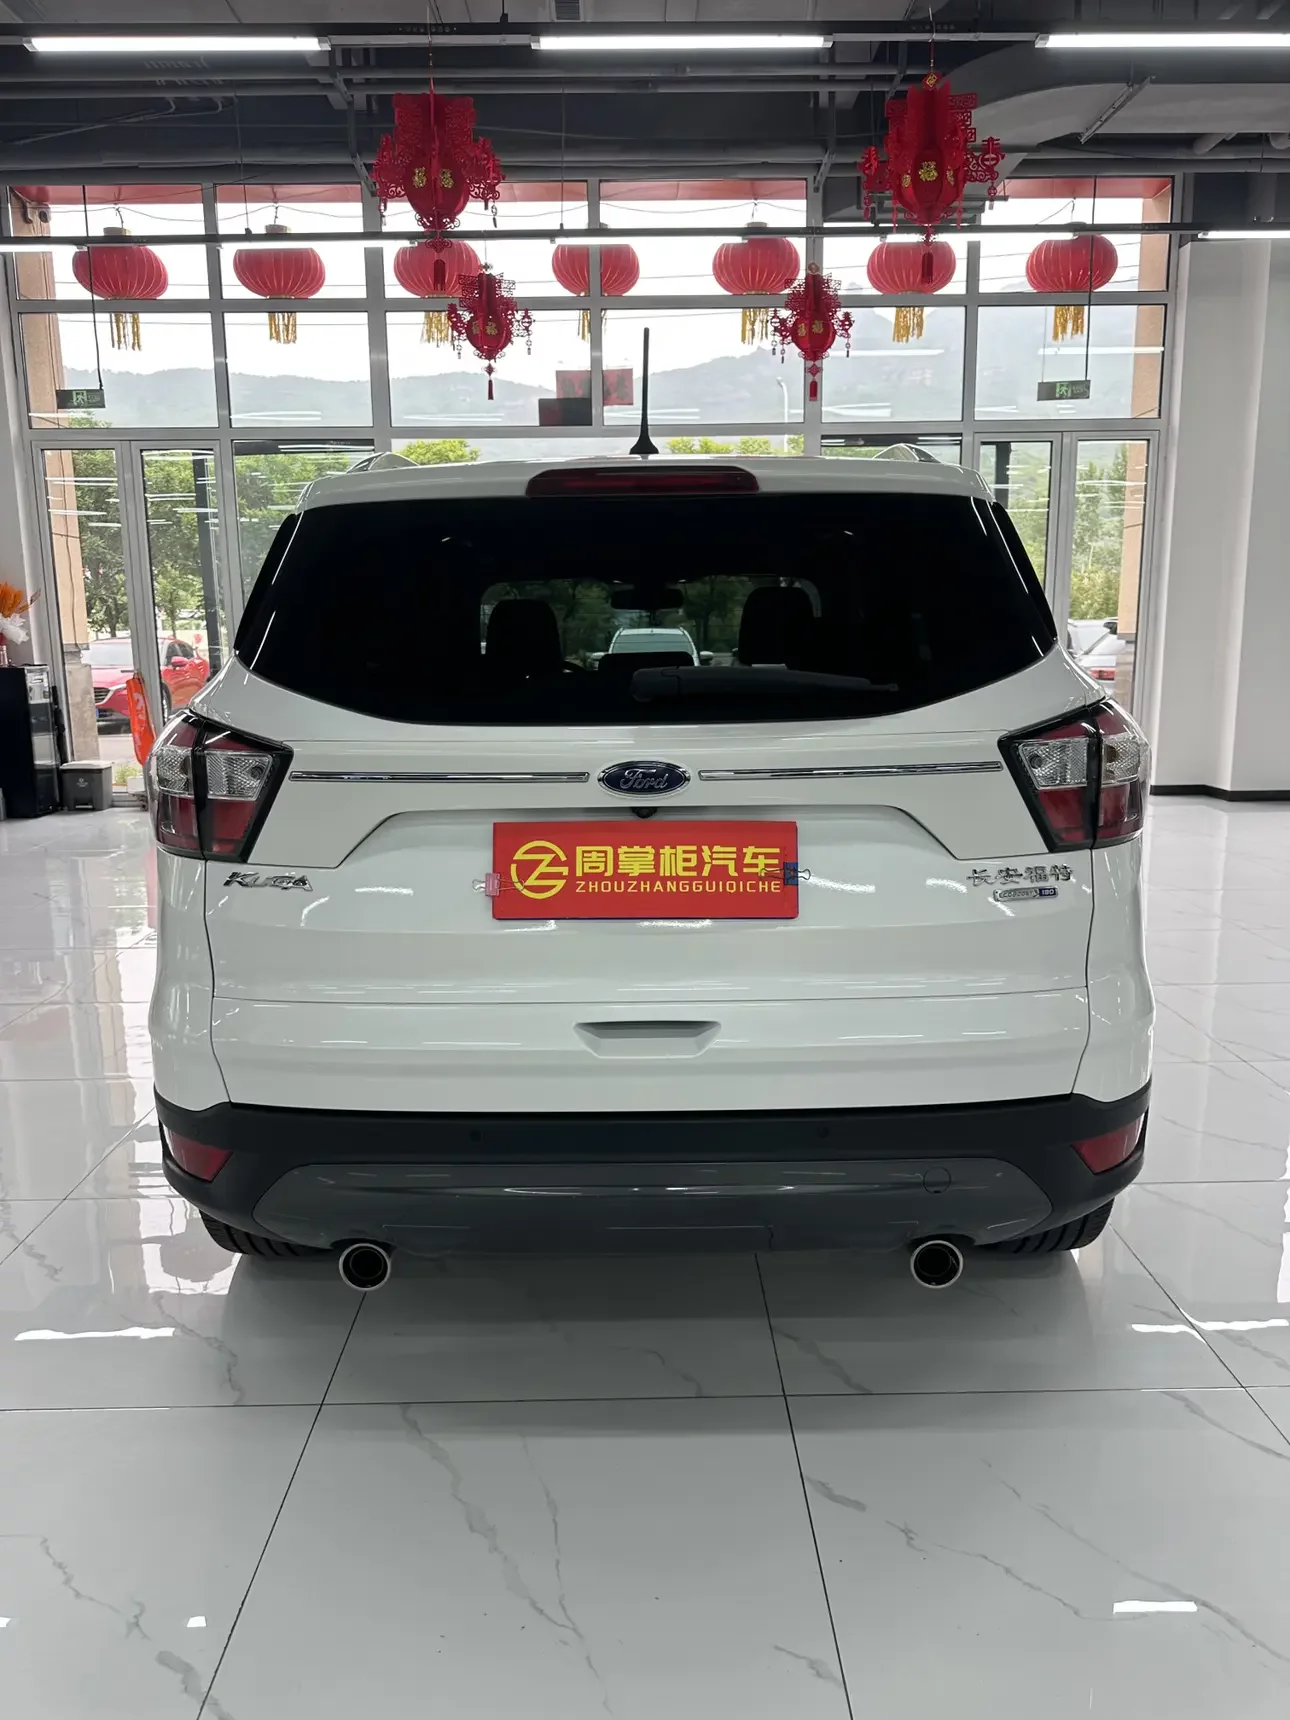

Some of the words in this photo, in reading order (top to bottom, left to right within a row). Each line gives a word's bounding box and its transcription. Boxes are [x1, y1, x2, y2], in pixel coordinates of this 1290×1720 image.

[620, 768, 669, 789] Ford
[575, 845, 781, 876] 周掌柜汽车
[223, 871, 313, 892] KUGA
[966, 864, 1073, 886] 长安福特
[575, 880, 781, 893] ZHOUZHANGGUIQICHE
